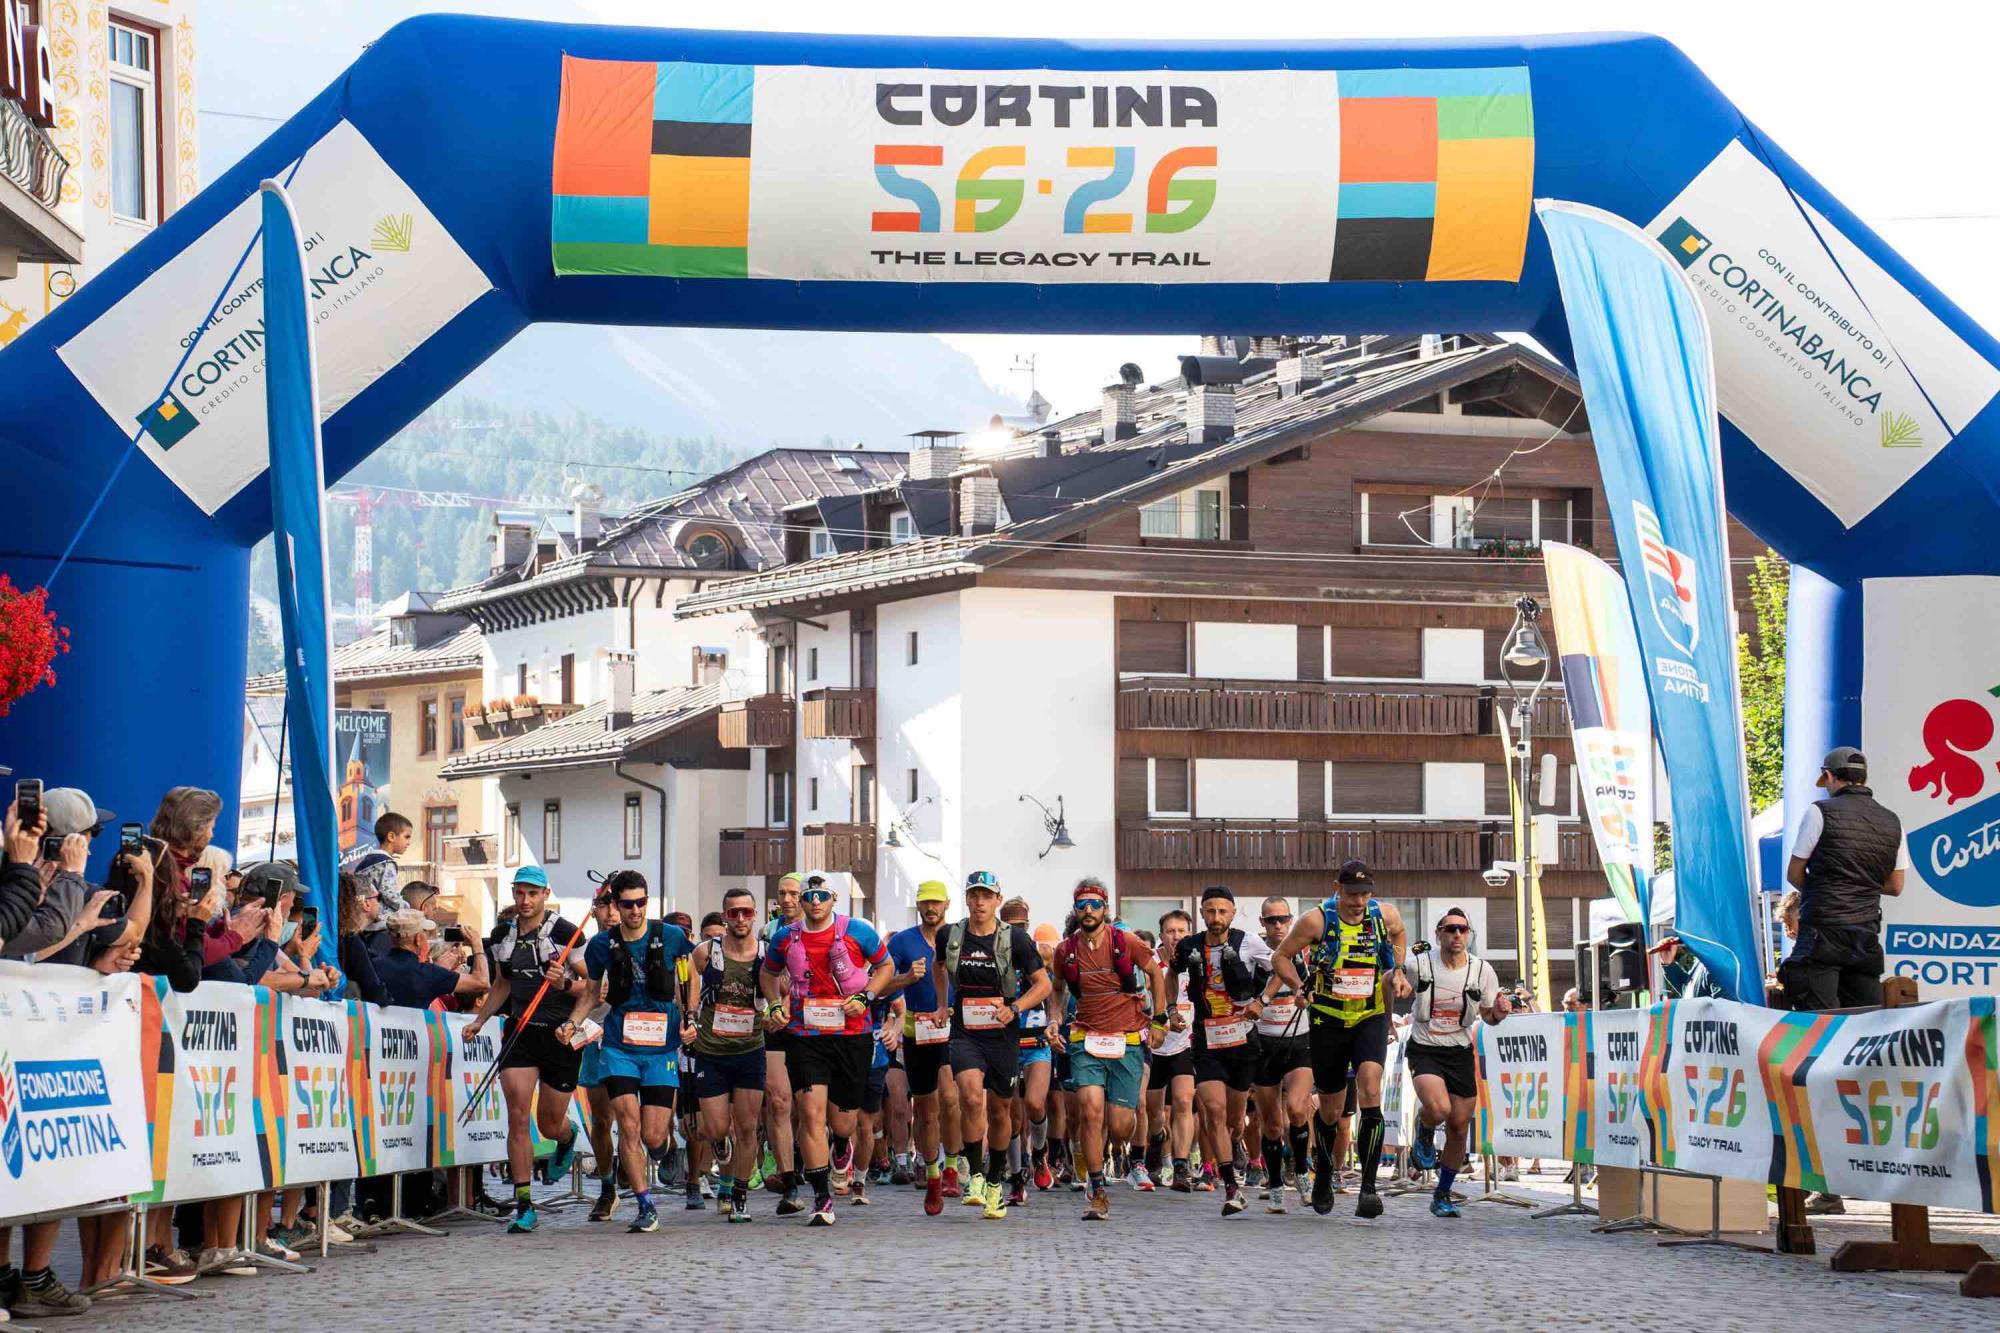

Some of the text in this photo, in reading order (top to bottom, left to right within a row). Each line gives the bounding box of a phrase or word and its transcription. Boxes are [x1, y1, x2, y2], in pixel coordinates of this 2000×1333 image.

[876, 83, 1217, 128] CORTINA
[870, 250, 1211, 266] THE LEGACY TRAIL
[1758, 248, 1887, 364] CON IL CONTRIBUTO DI
[201, 374, 249, 415] CREDITO
[333, 266, 385, 311] ITALIANO
[1708, 253, 1883, 414] CORTINABANCA
[1690, 273, 1864, 426] CREDITO COOPERATIVO ITALIANO
[381, 1028, 418, 1060] CORTINA
[1496, 1035, 1547, 1063] CORTINA
[1843, 1028, 1945, 1067] CORTINA
[19, 1069, 105, 1100] FONDAZIONE
[25, 1113, 127, 1162] CORTINA
[298, 1142, 315, 1155] THE
[316, 1142, 337, 1154] LEGACY
[1504, 1129, 1552, 1139] THE LEGACY TRAIL
[1608, 1134, 1619, 1145] THE
[1713, 1138, 1743, 1153] TRAIL
[1848, 1159, 1952, 1179] THE LEGACY TRAIL
